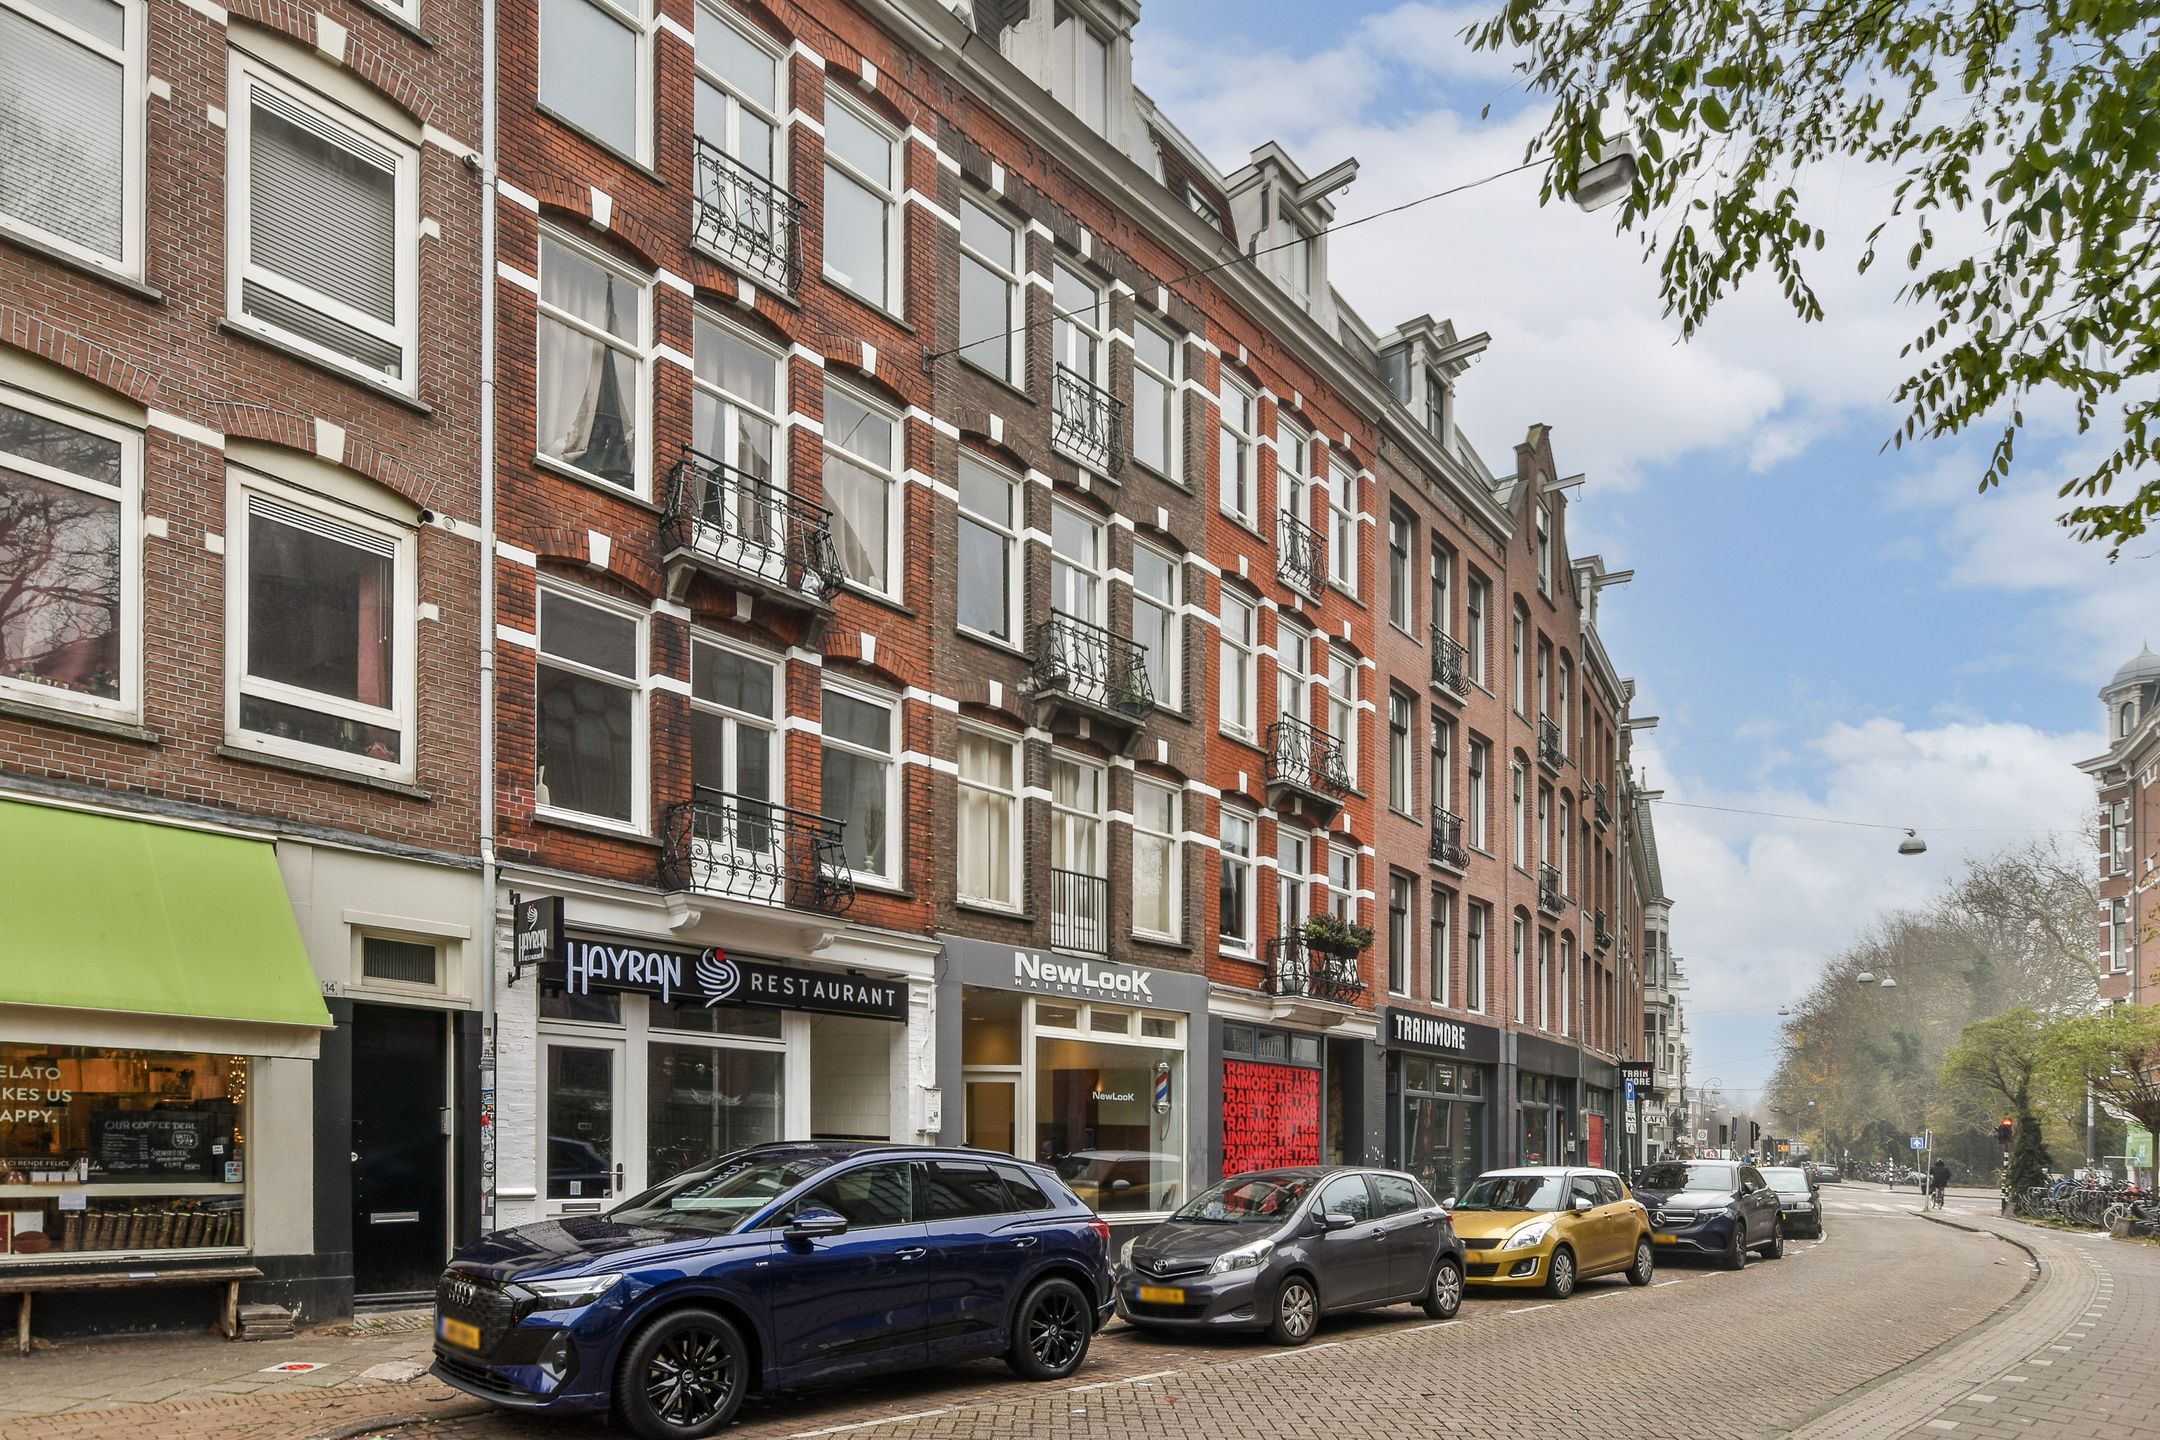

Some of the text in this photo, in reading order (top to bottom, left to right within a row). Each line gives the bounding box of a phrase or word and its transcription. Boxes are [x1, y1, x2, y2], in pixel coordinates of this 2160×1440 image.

[518, 928, 547, 961] HAYRAN
[567, 941, 896, 1007] HAYRAN RESTAURANT
[324, 982, 336, 993] 14
[1014, 977, 1153, 1003] HAIRSTYLING
[1395, 1014, 1466, 1051] TRAINMORE
[0, 1065, 62, 1080] ELATO
[1622, 1069, 1649, 1078] TRAIN
[1627, 1082, 1633, 1093] P
[47, 1089, 73, 1102] US
[0, 1109, 57, 1123] APPY.
[104, 1121, 197, 1130] OUR COFFEE DEAL
[18, 1160, 43, 1168] RENDE
